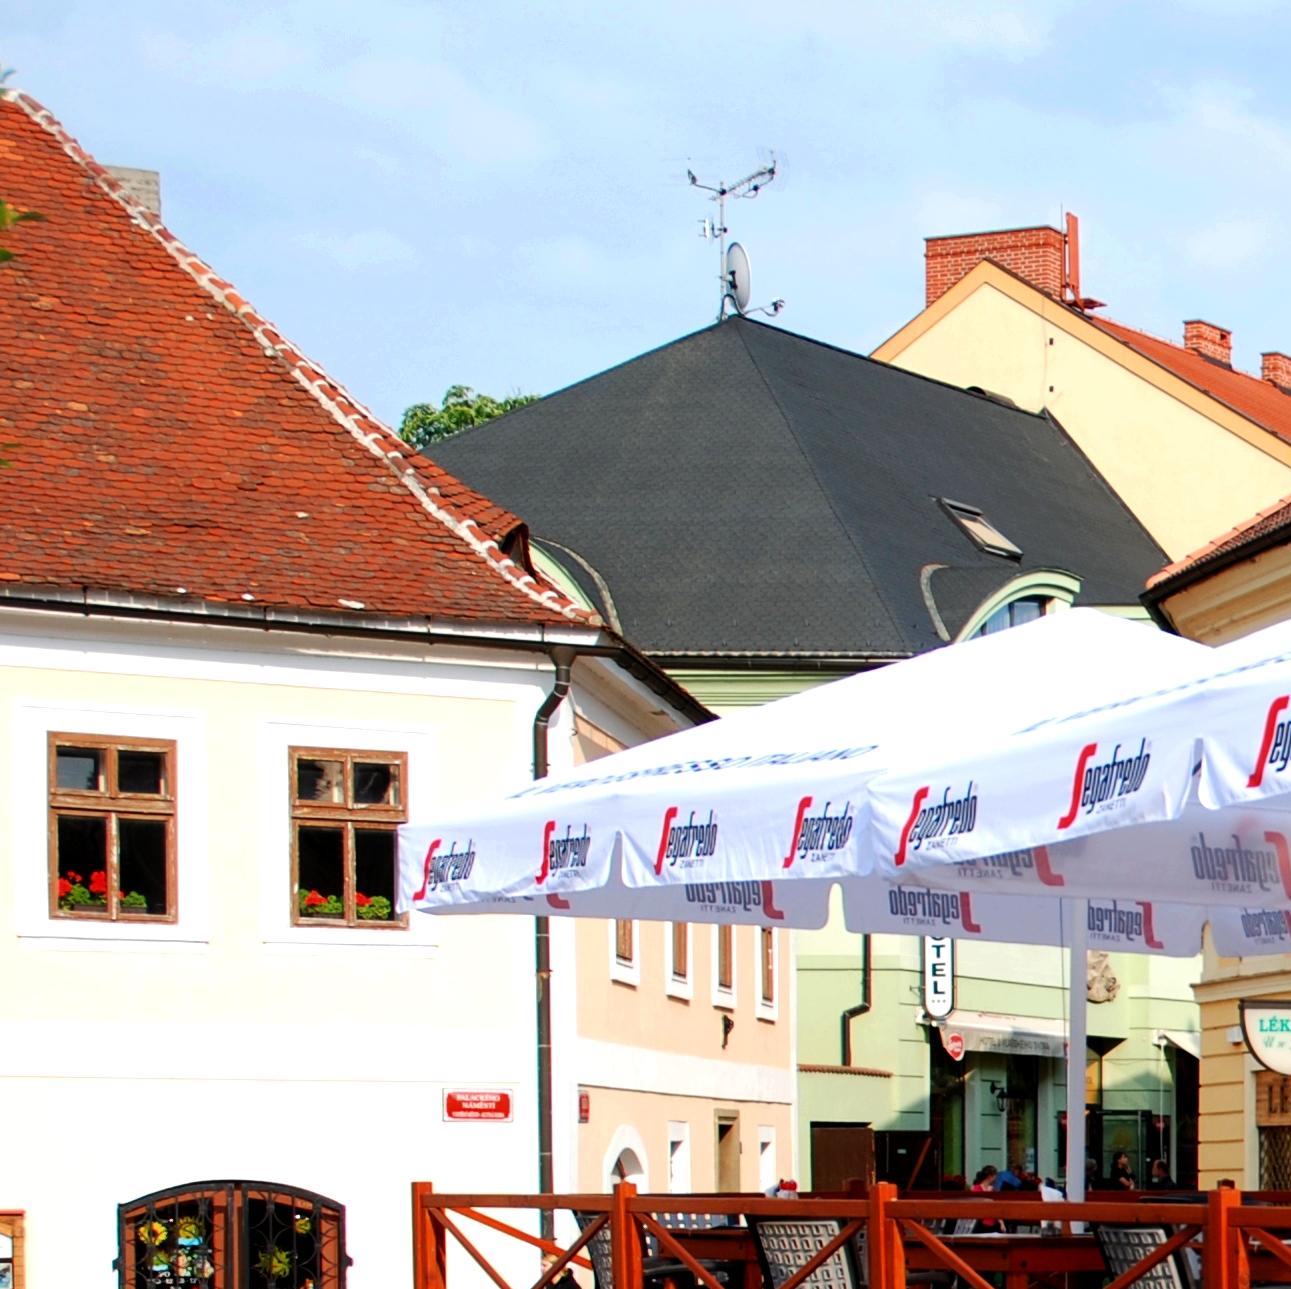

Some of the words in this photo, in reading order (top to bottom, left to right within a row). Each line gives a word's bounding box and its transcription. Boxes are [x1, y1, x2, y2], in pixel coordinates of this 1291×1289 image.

[1057, 737, 1150, 830] Segafredo
[654, 806, 718, 875] Segafredo
[782, 796, 852, 868] Segafredo
[894, 780, 978, 866] Segafredo
[931, 937, 946, 994] TEL
